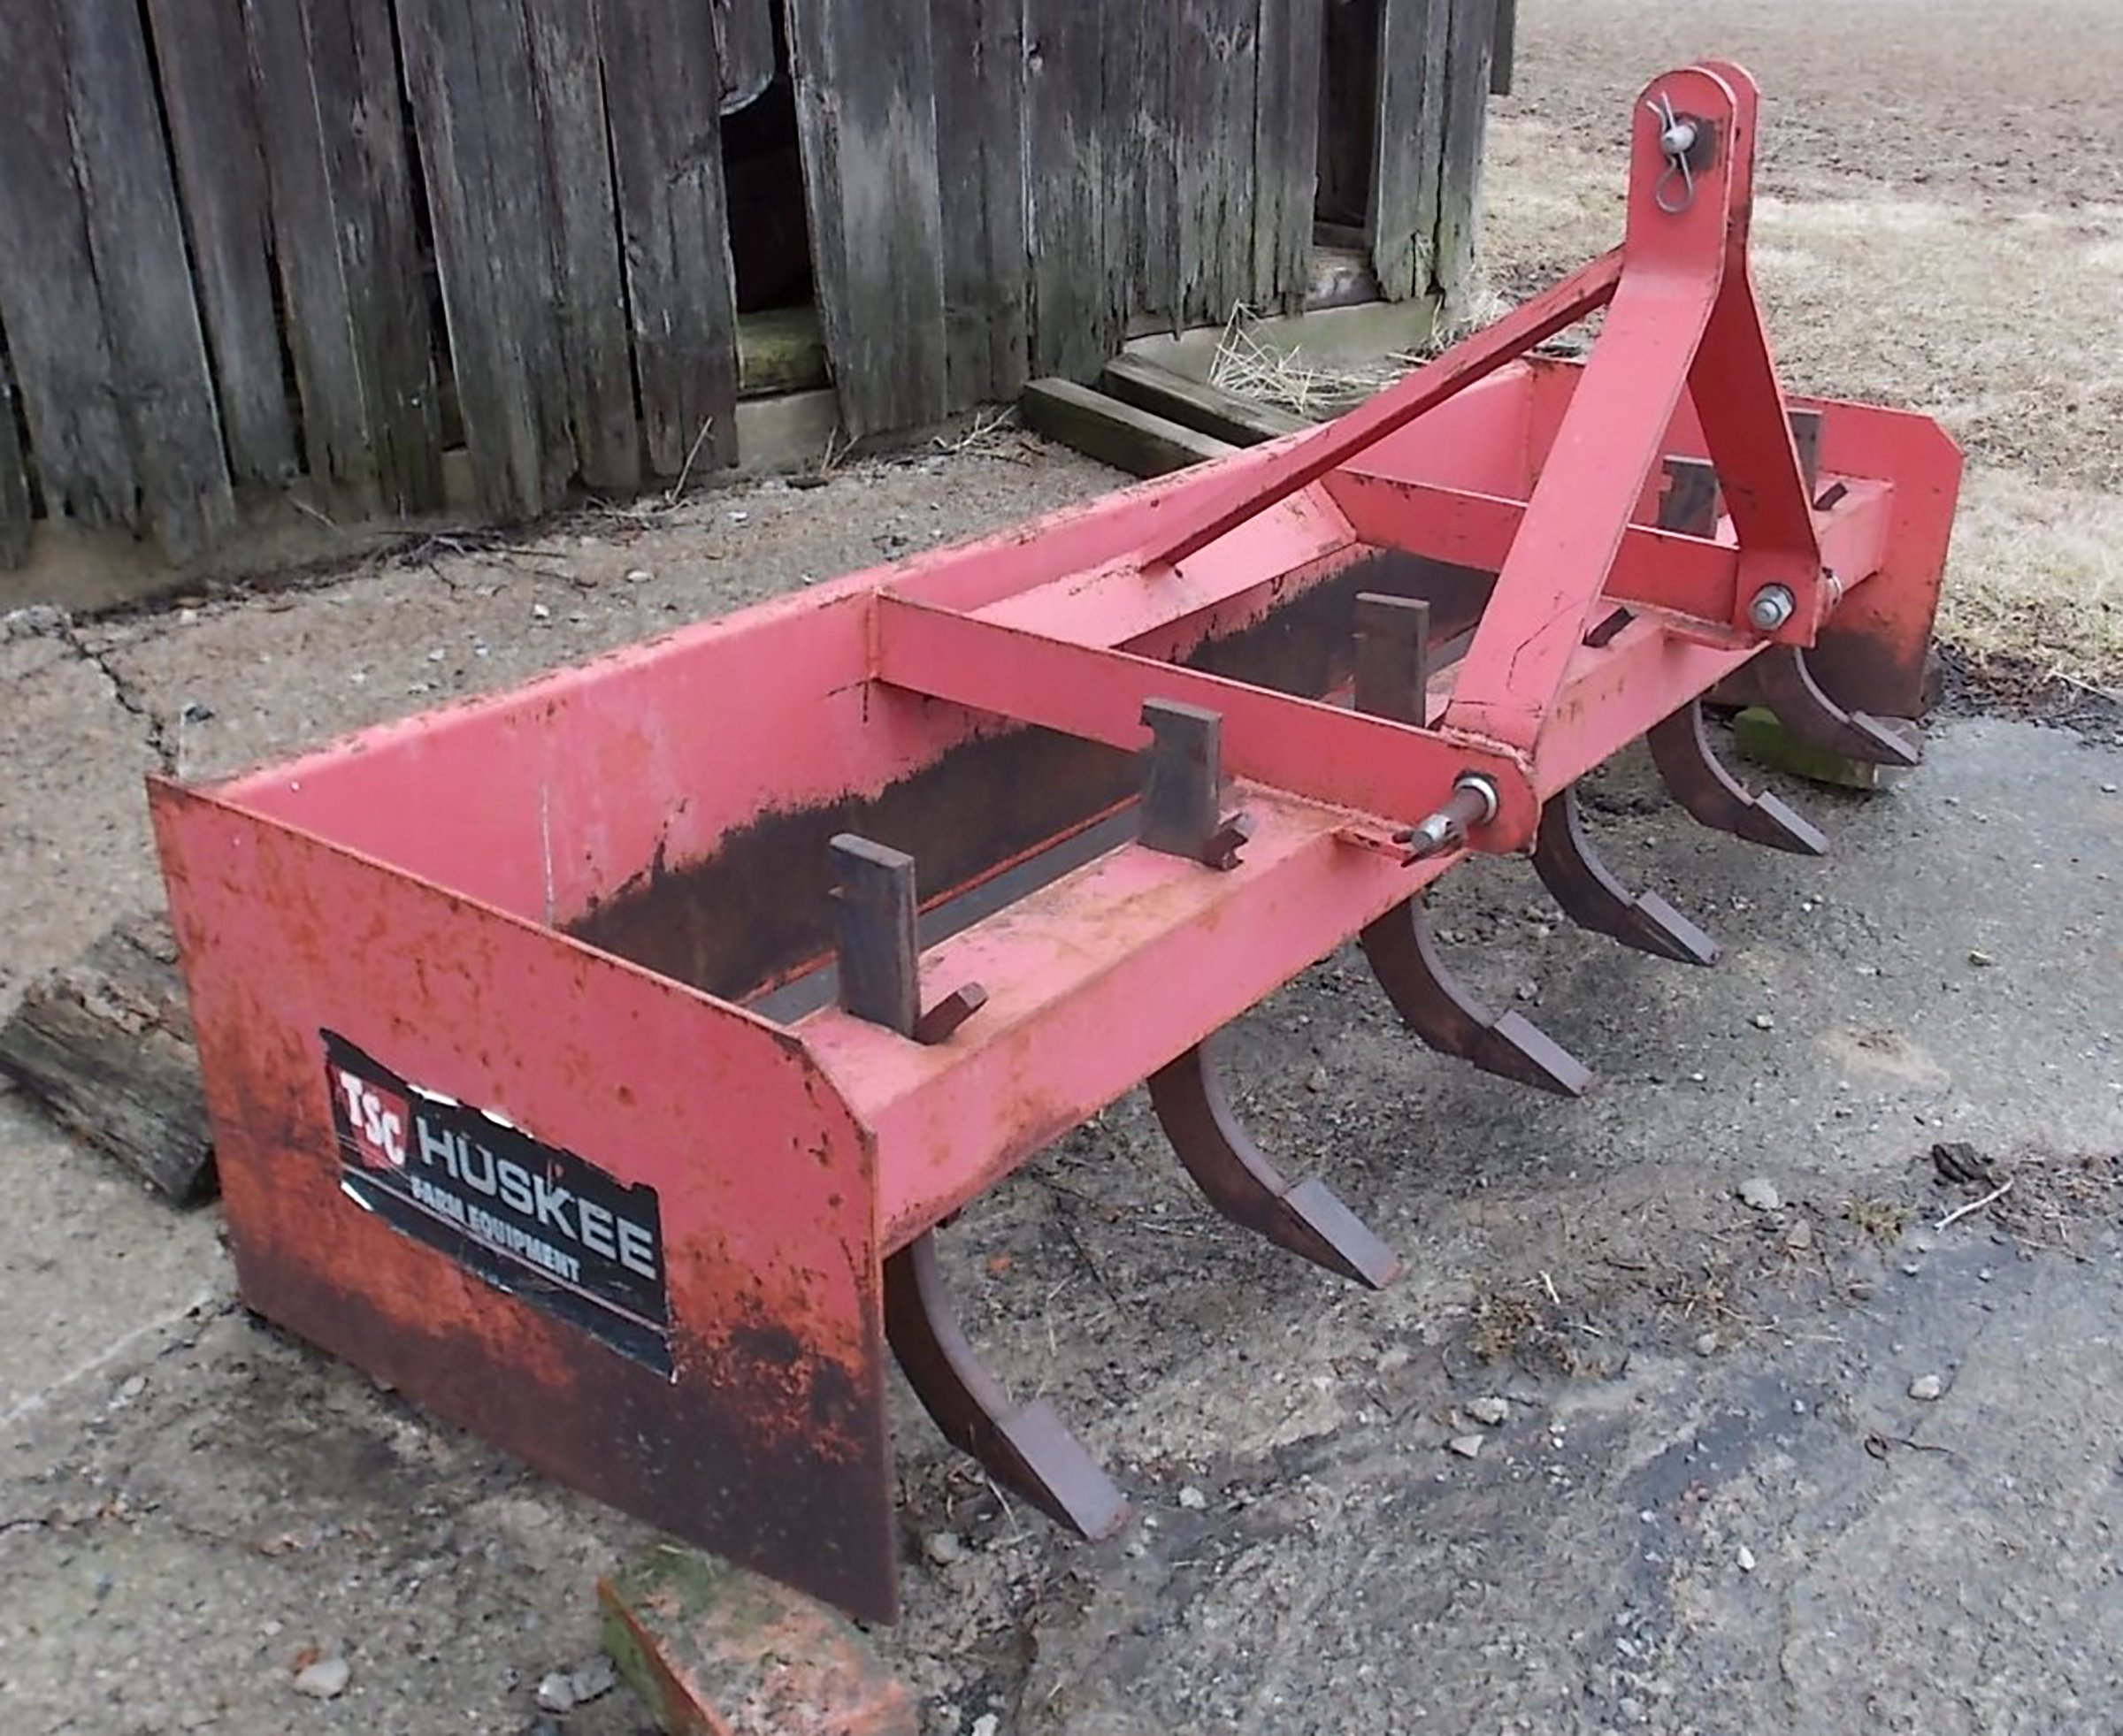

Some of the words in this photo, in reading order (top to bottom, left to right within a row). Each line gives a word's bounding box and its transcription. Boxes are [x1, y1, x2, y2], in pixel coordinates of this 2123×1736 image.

[340, 1070, 405, 1166] TSC
[416, 1116, 656, 1281] HUSKEE
[466, 1203, 581, 1282] EQUIPMENT
